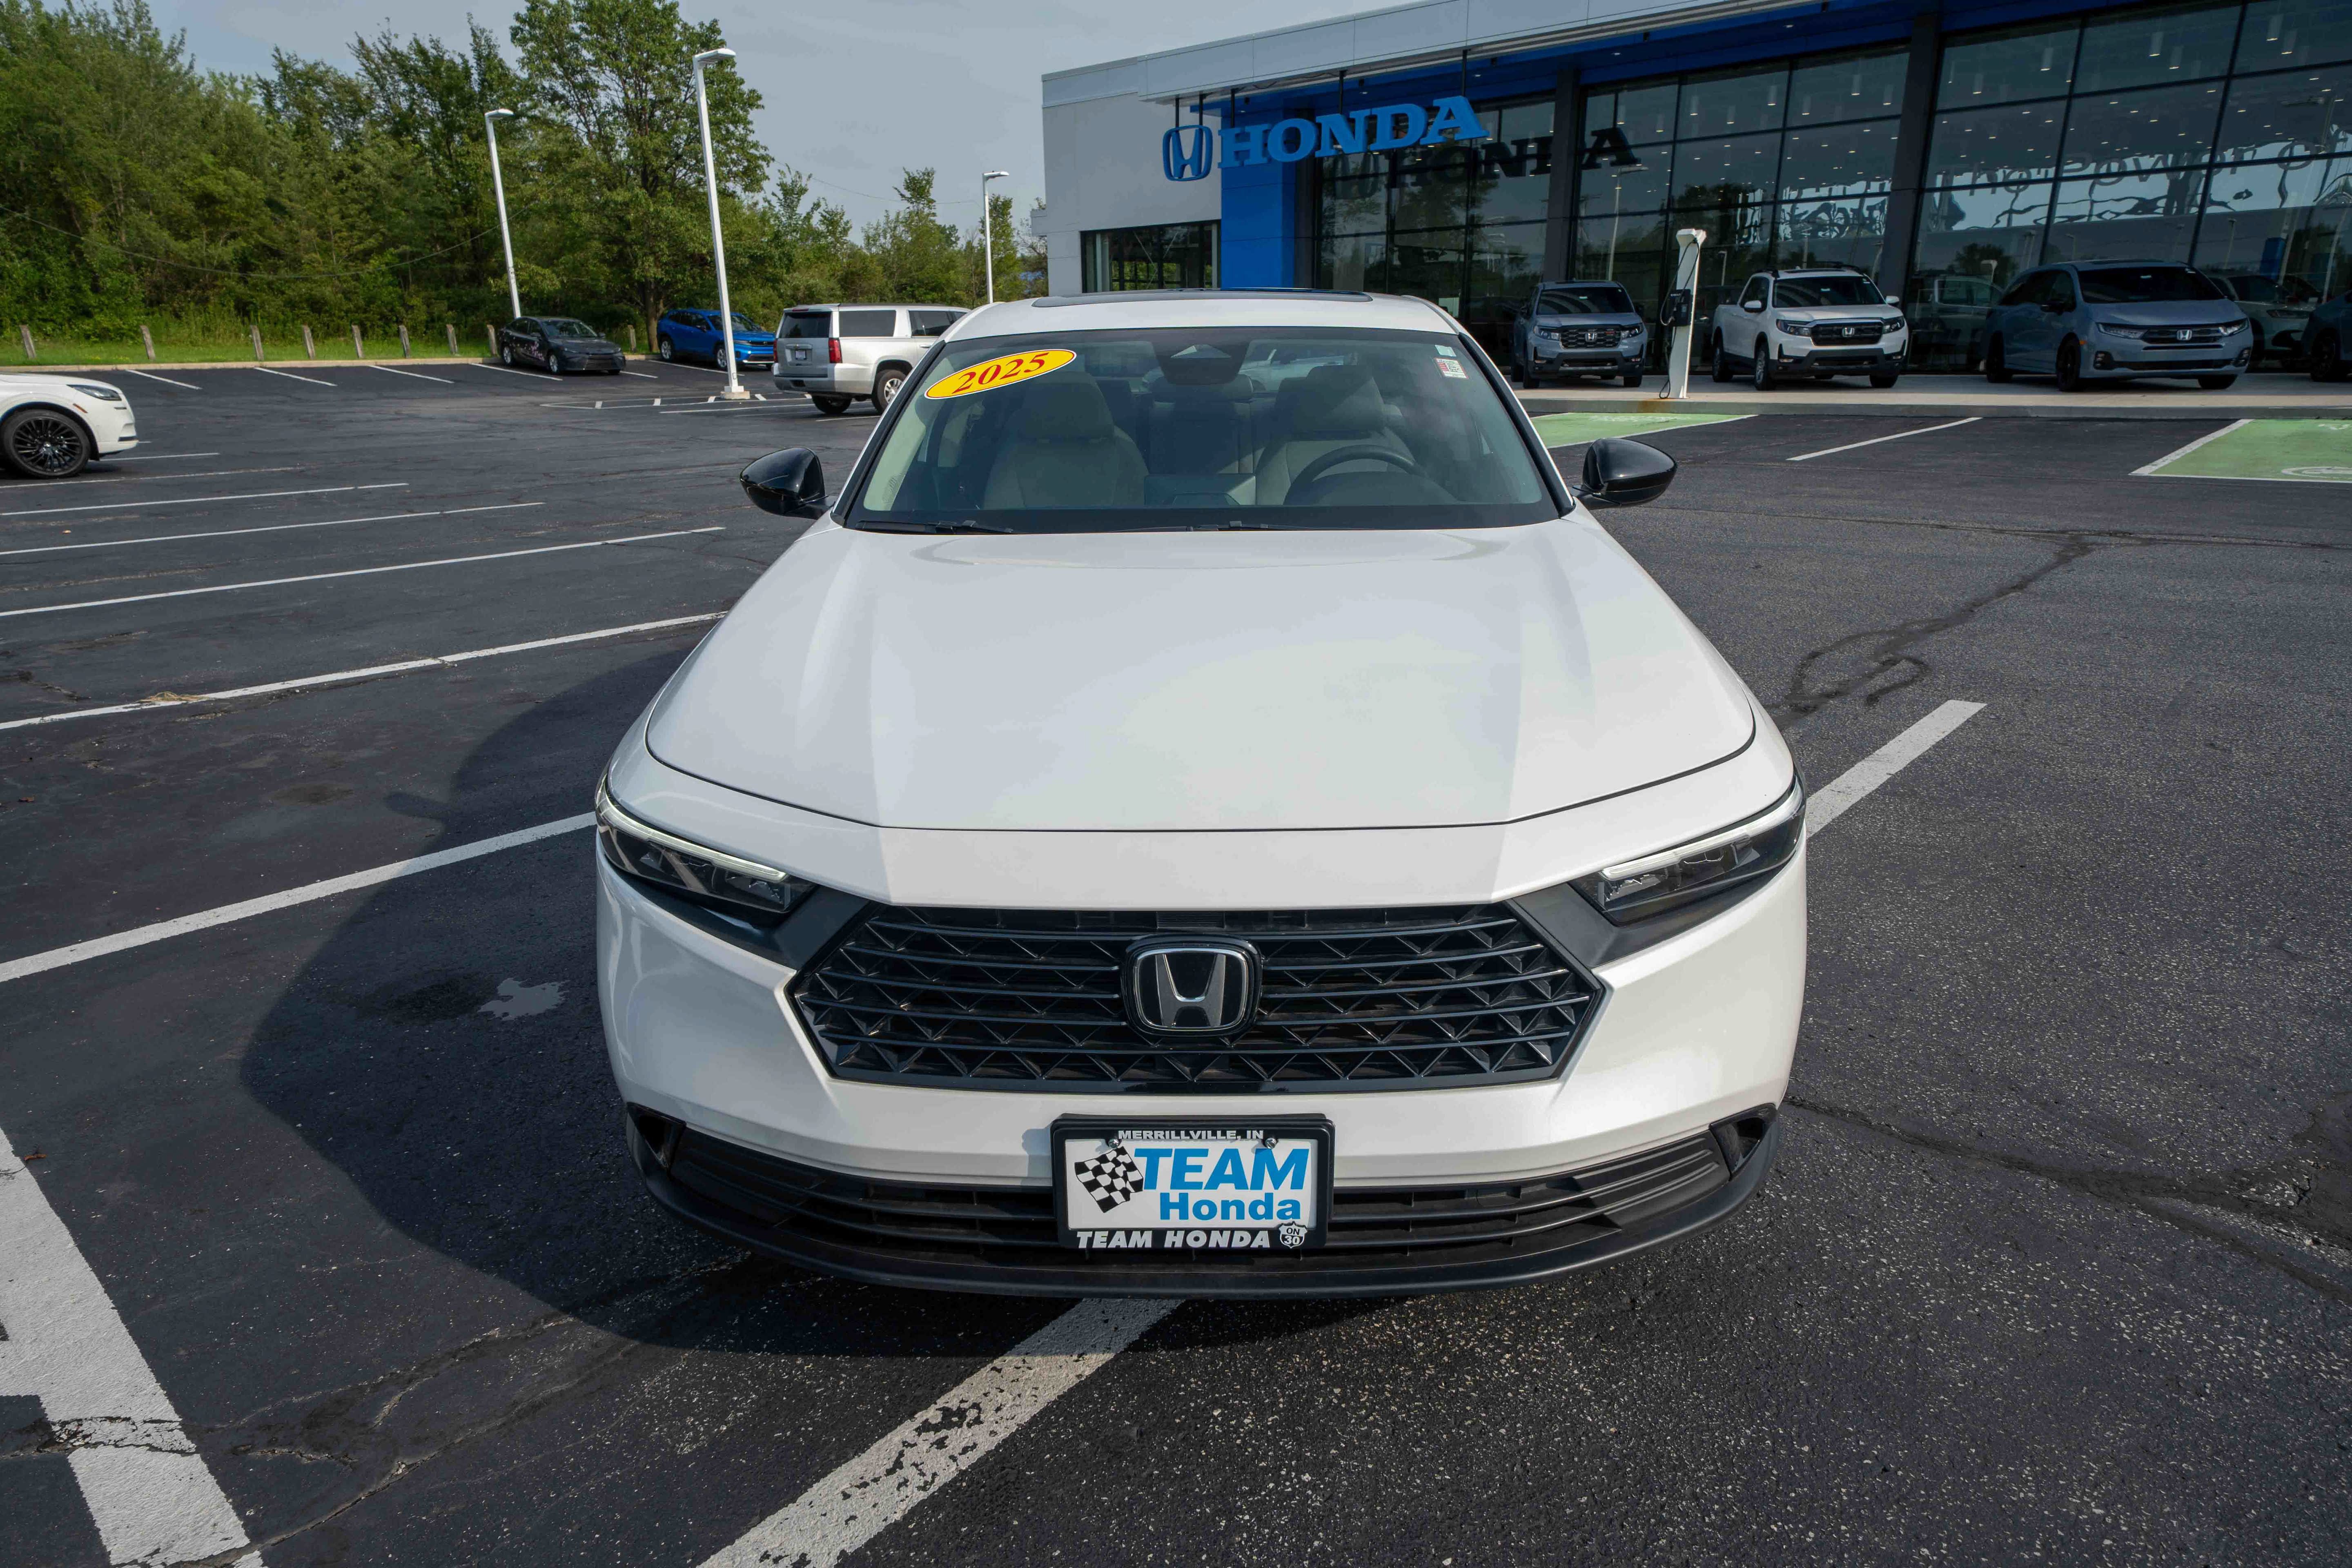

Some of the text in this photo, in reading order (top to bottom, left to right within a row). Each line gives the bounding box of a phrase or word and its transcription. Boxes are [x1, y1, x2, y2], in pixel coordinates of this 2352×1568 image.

[1218, 95, 1490, 168] HONDA
[952, 352, 1049, 394] 2025
[1118, 1130, 1264, 1140] MERRILLVILLE, IN
[1134, 1148, 1310, 1190] TEAM
[1160, 1192, 1301, 1221] Honda
[1076, 1231, 1270, 1249] TEAM HONDA
[1284, 1235, 1300, 1245] 30
